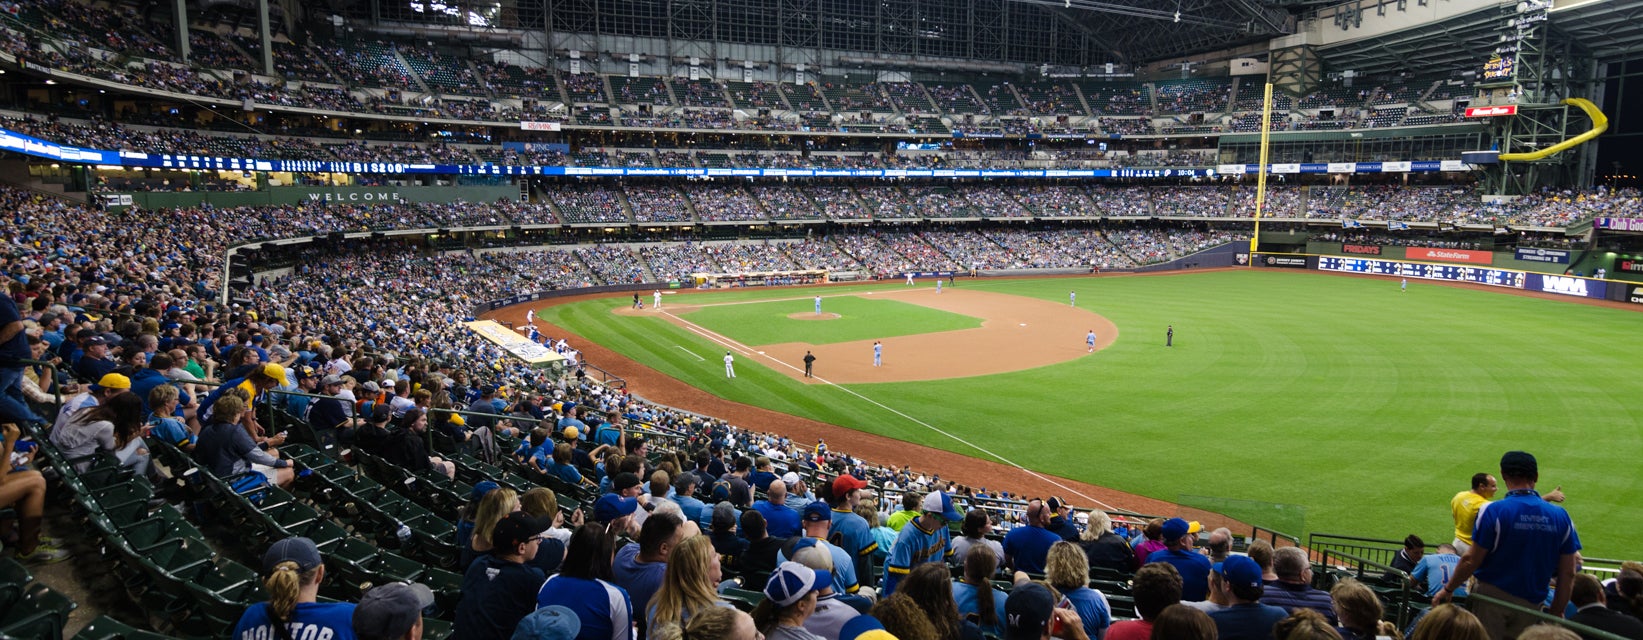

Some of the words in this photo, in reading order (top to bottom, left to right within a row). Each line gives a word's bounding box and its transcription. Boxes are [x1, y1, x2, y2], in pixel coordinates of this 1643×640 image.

[309, 193, 400, 201] WELCOME
[1611, 217, 1627, 230] Club
[1343, 244, 1380, 255] FRIDAYS
